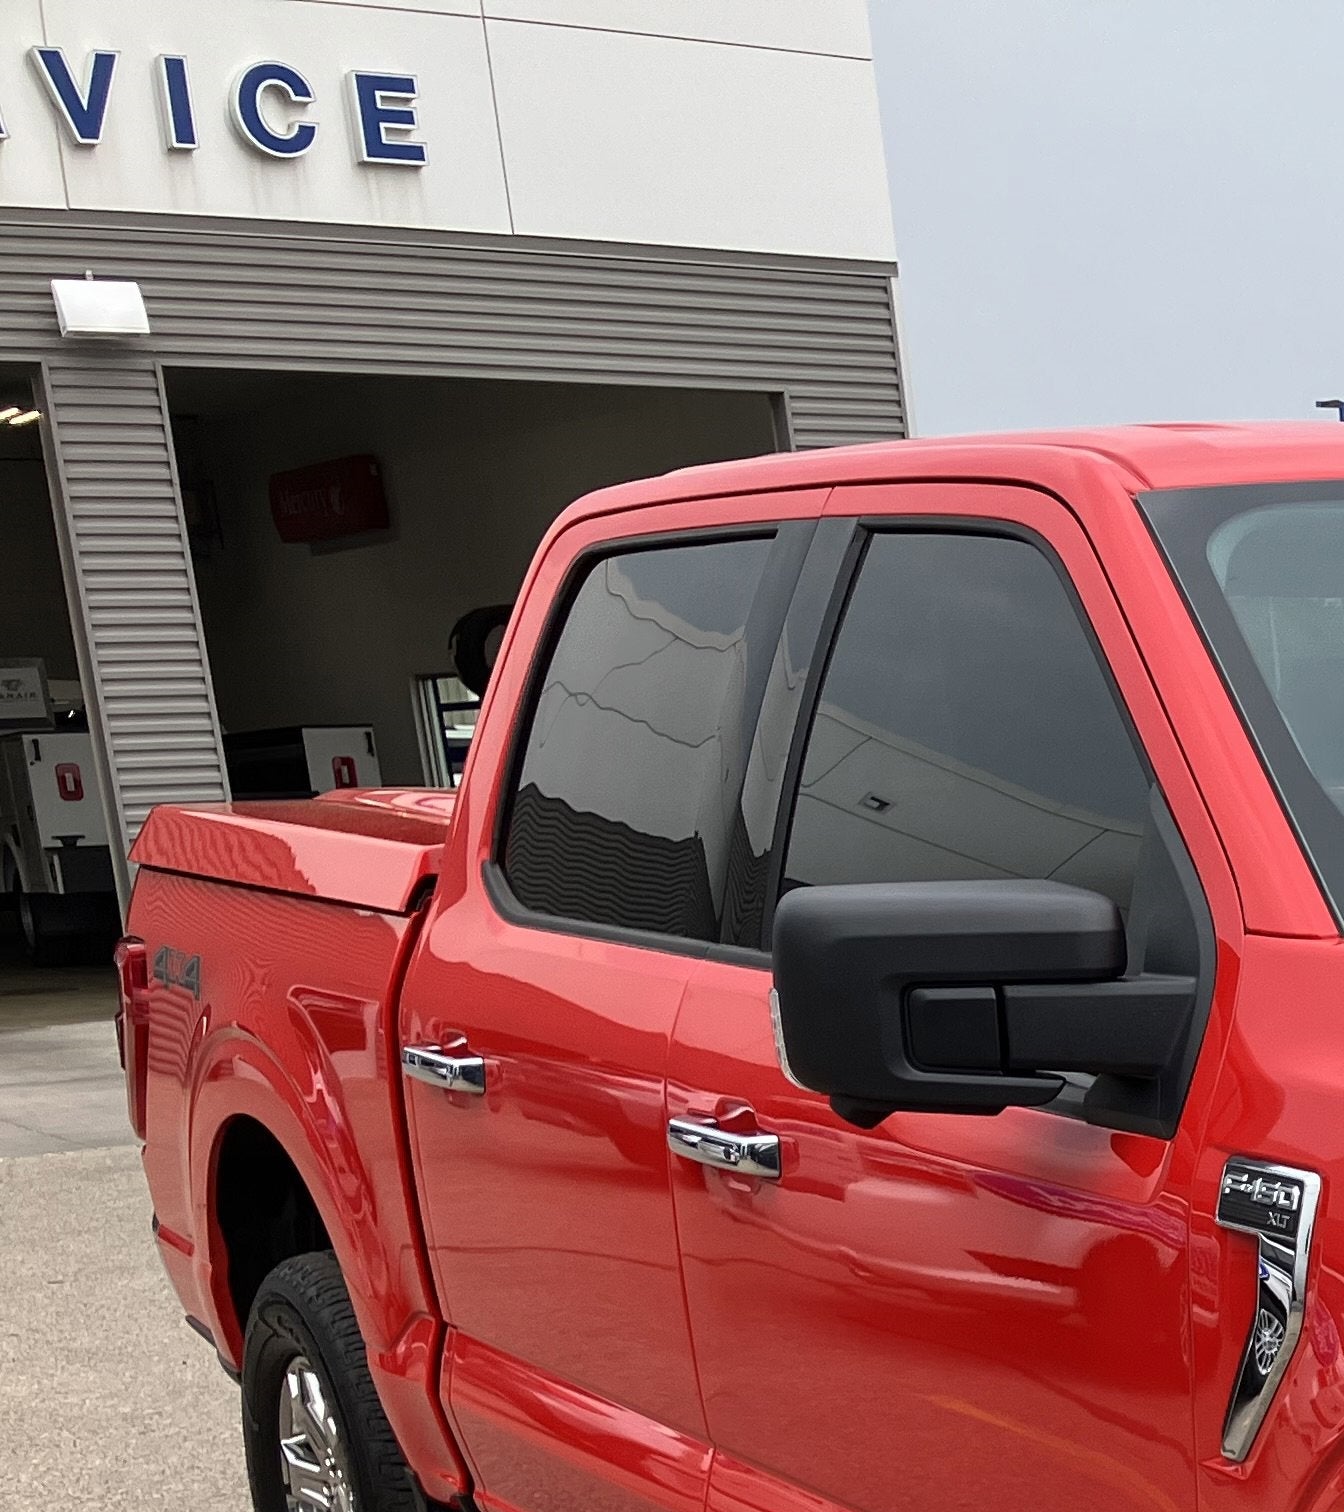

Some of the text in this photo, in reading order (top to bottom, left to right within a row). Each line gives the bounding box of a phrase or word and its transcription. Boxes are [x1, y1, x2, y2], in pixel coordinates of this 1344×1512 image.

[0, 46, 428, 165] VICE
[1223, 1174, 1300, 1210] F-150
[1266, 1211, 1290, 1228] XLT
